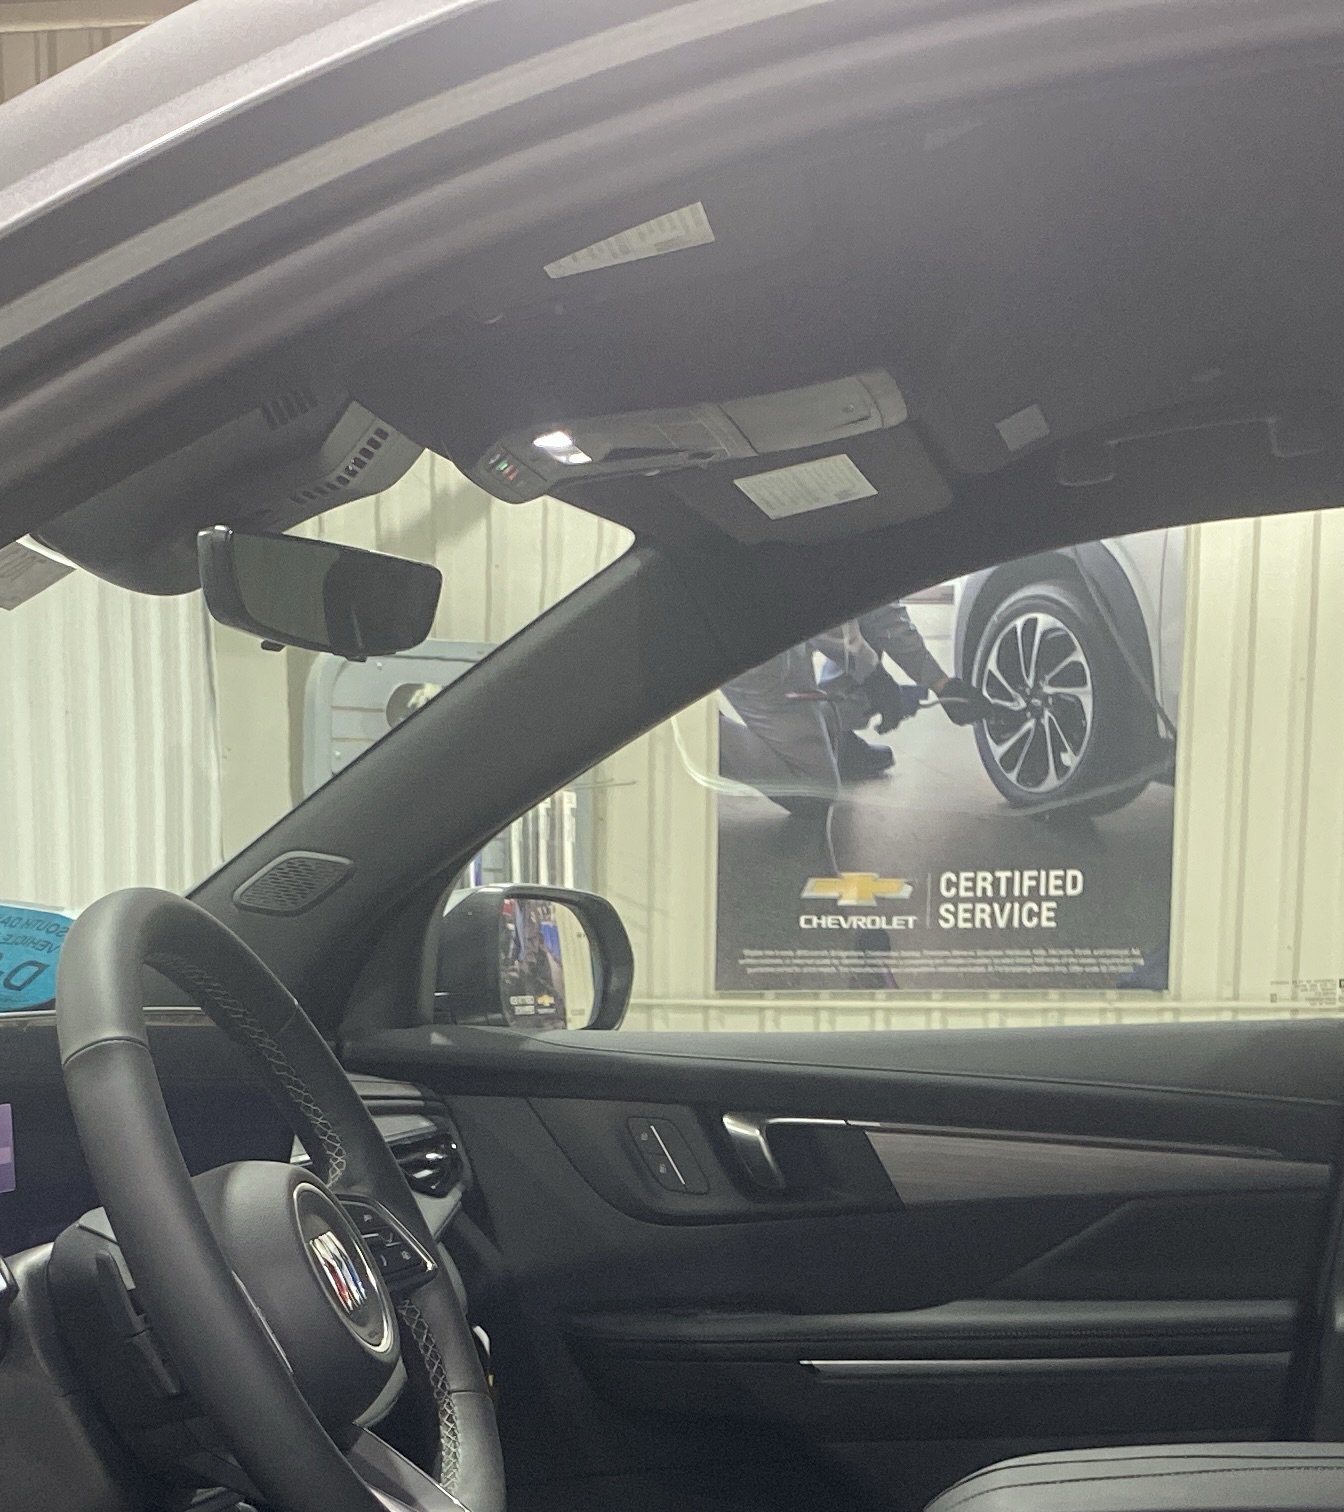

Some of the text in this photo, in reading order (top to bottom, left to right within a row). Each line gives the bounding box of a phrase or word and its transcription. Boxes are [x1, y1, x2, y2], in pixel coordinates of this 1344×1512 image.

[939, 869, 1084, 898] CERTIFIED
[799, 914, 918, 930] CHEVROLET
[938, 901, 1057, 929] SERVICE
